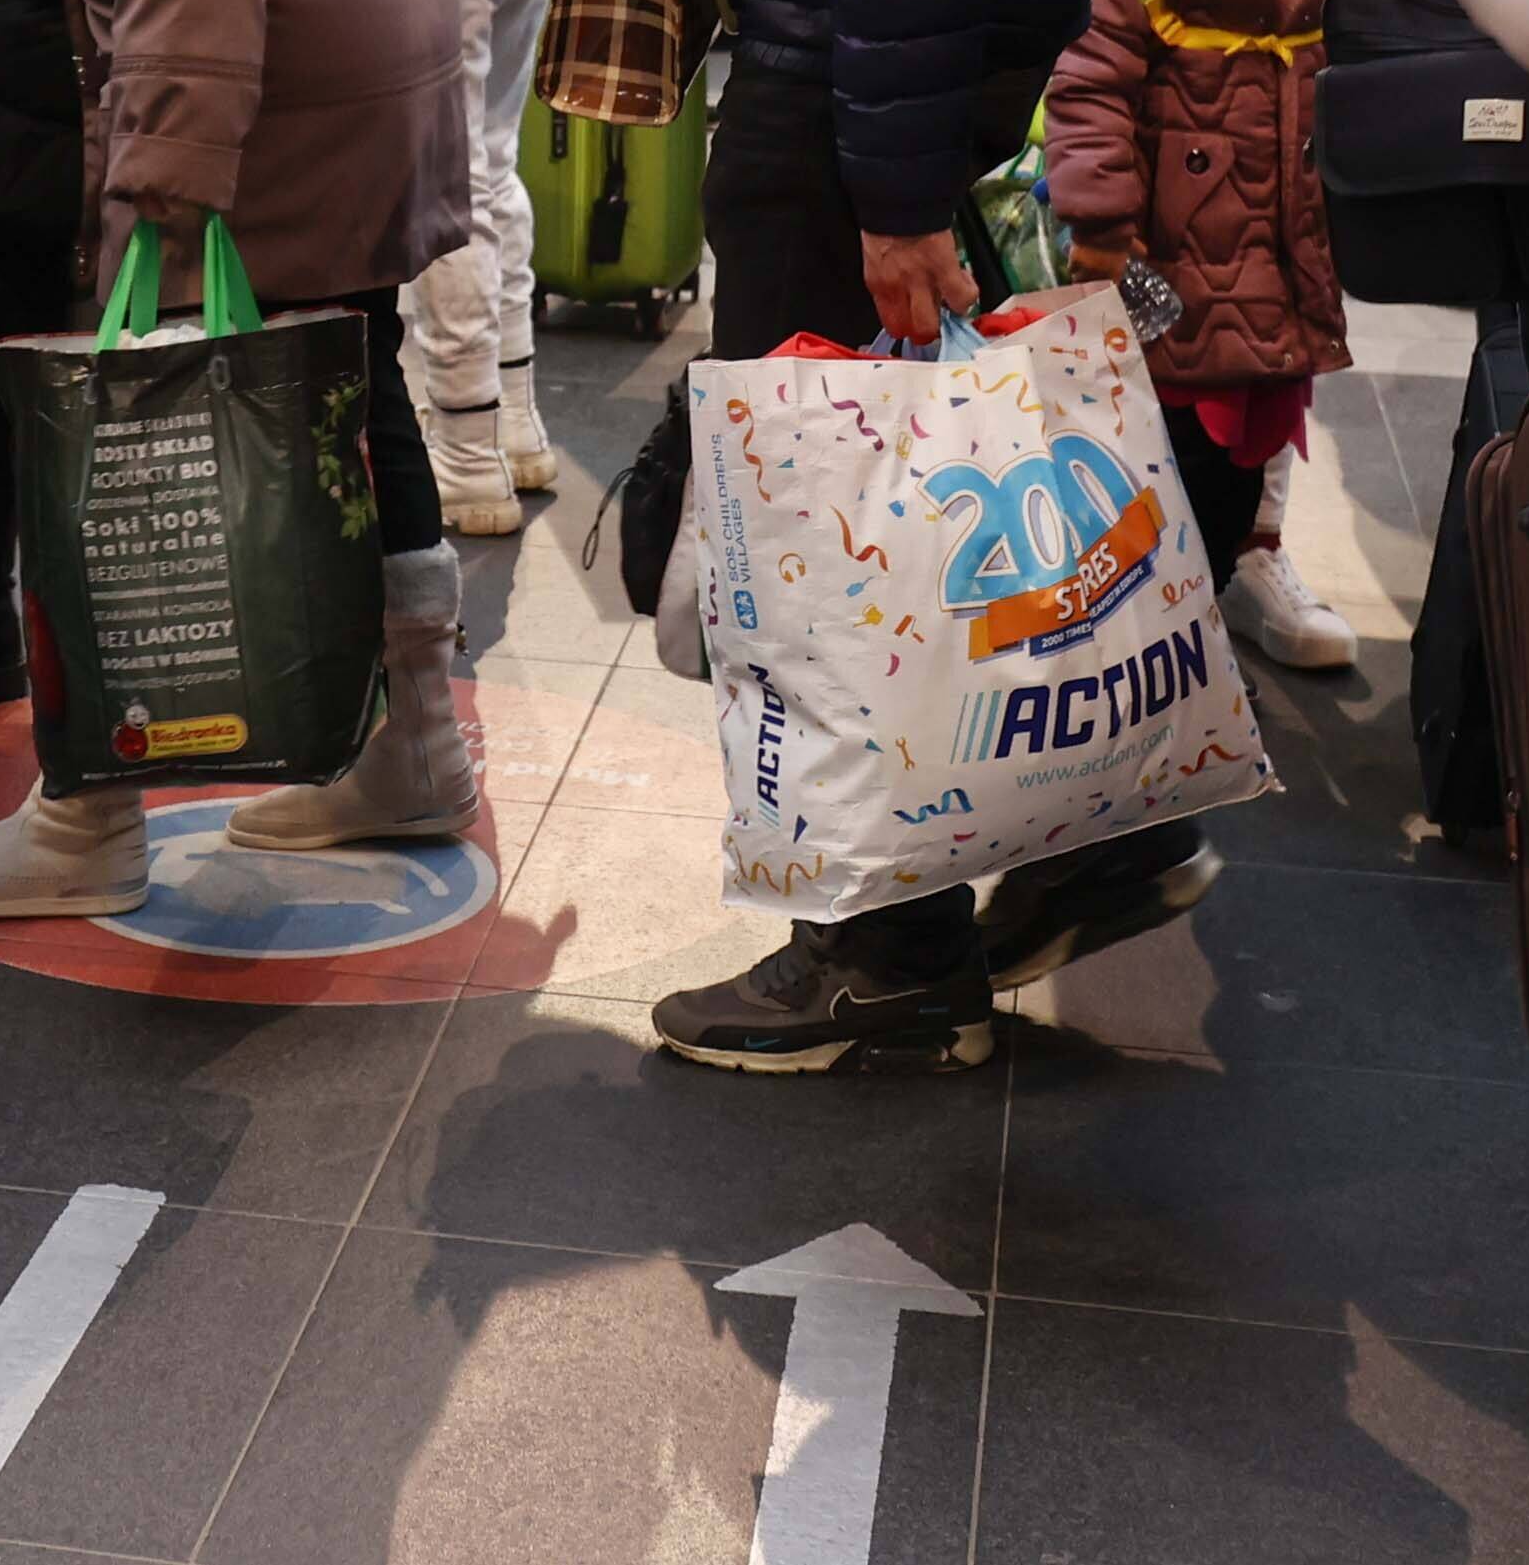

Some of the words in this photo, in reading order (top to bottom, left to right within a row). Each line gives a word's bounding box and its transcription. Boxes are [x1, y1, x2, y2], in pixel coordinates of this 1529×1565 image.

[179, 459, 218, 480] BIO
[711, 433, 733, 542] CHILDREN'S
[81, 515, 141, 538] Soki
[148, 506, 222, 532] 100%
[83, 530, 226, 558] naturalne
[731, 497, 752, 584] VILLAGES
[725, 546, 740, 583] SOS
[133, 618, 235, 647] LAKTOZY
[994, 619, 1208, 760] ACTION
[747, 662, 786, 810] ACTION
[1015, 723, 1175, 789] www.action.com
